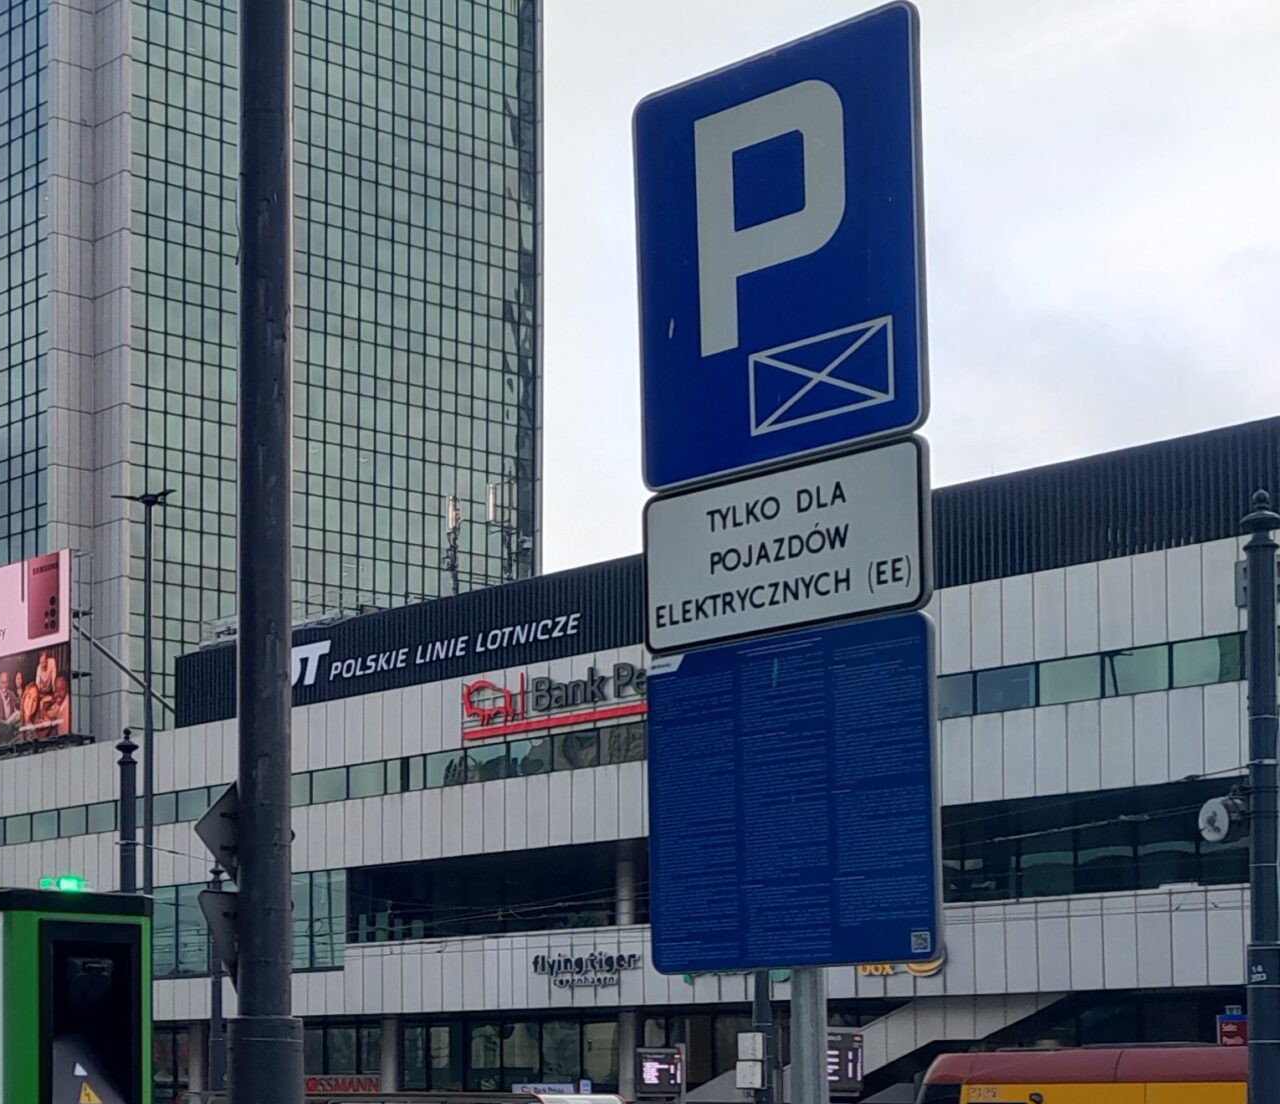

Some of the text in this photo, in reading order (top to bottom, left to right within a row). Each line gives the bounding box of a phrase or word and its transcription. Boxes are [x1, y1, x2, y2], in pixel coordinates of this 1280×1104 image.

[694, 79, 846, 357] P
[706, 481, 847, 532] TYLKO DLA
[710, 522, 850, 575] POJAZDÓW
[655, 554, 912, 629] ELEKTRYCZNYCH (EE)
[328, 648, 409, 681] POLSKIE
[415, 635, 469, 665] LINIE
[475, 612, 582, 653] LOTNICZE
[531, 662, 648, 712] Bank Pe
[532, 951, 637, 976] flying tiger
[553, 976, 616, 988] copenhagen
[306, 1076, 379, 1093] OSSMANN
